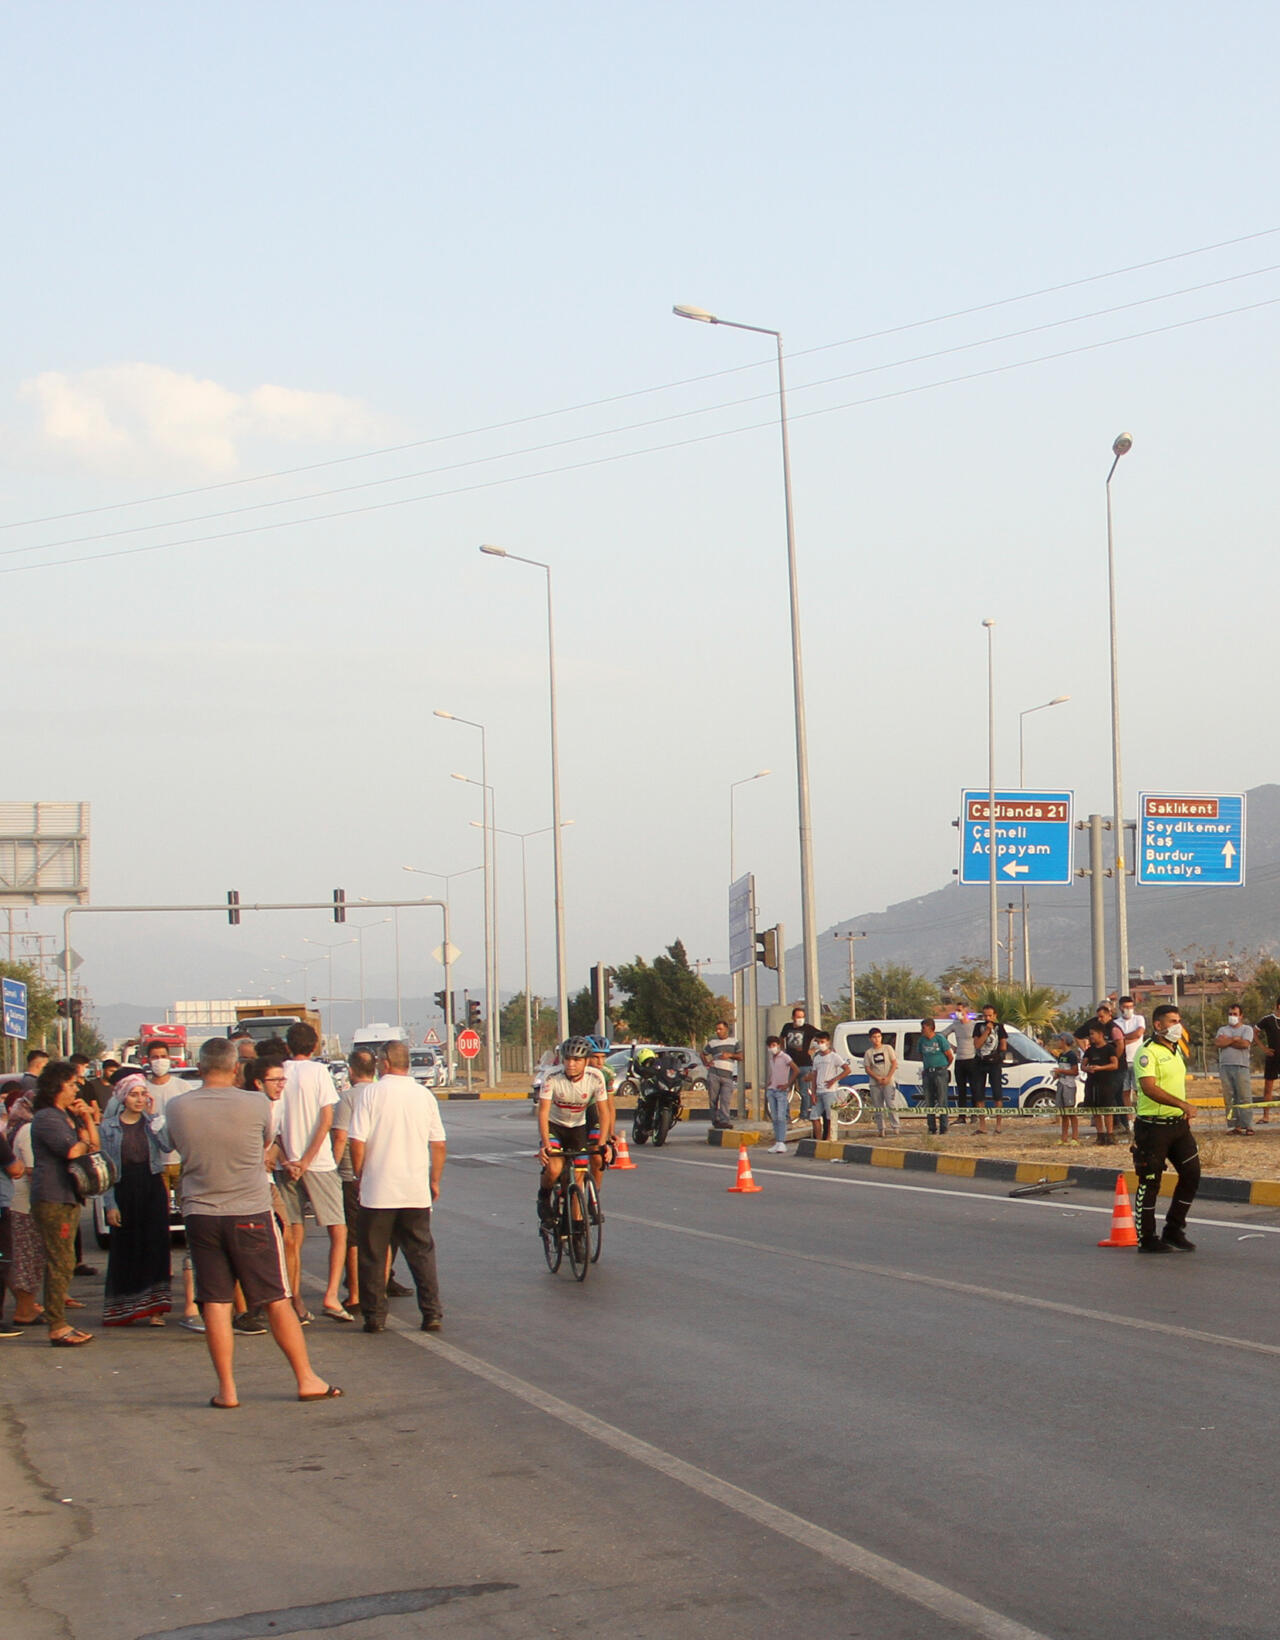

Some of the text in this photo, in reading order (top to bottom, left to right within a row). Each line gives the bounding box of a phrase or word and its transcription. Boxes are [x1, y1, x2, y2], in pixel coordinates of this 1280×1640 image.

[972, 804, 1064, 817] Cadianda 21
[1148, 802, 1213, 814] Saklıkent
[973, 825, 1027, 839] Çameli
[1146, 821, 1232, 835] Seydikemer
[1146, 834, 1173, 847] Kaş
[1146, 849, 1194, 861] Burdur
[1146, 863, 1202, 877] Antalya
[460, 1038, 479, 1050] DUR
[787, 1032, 804, 1046] 23
